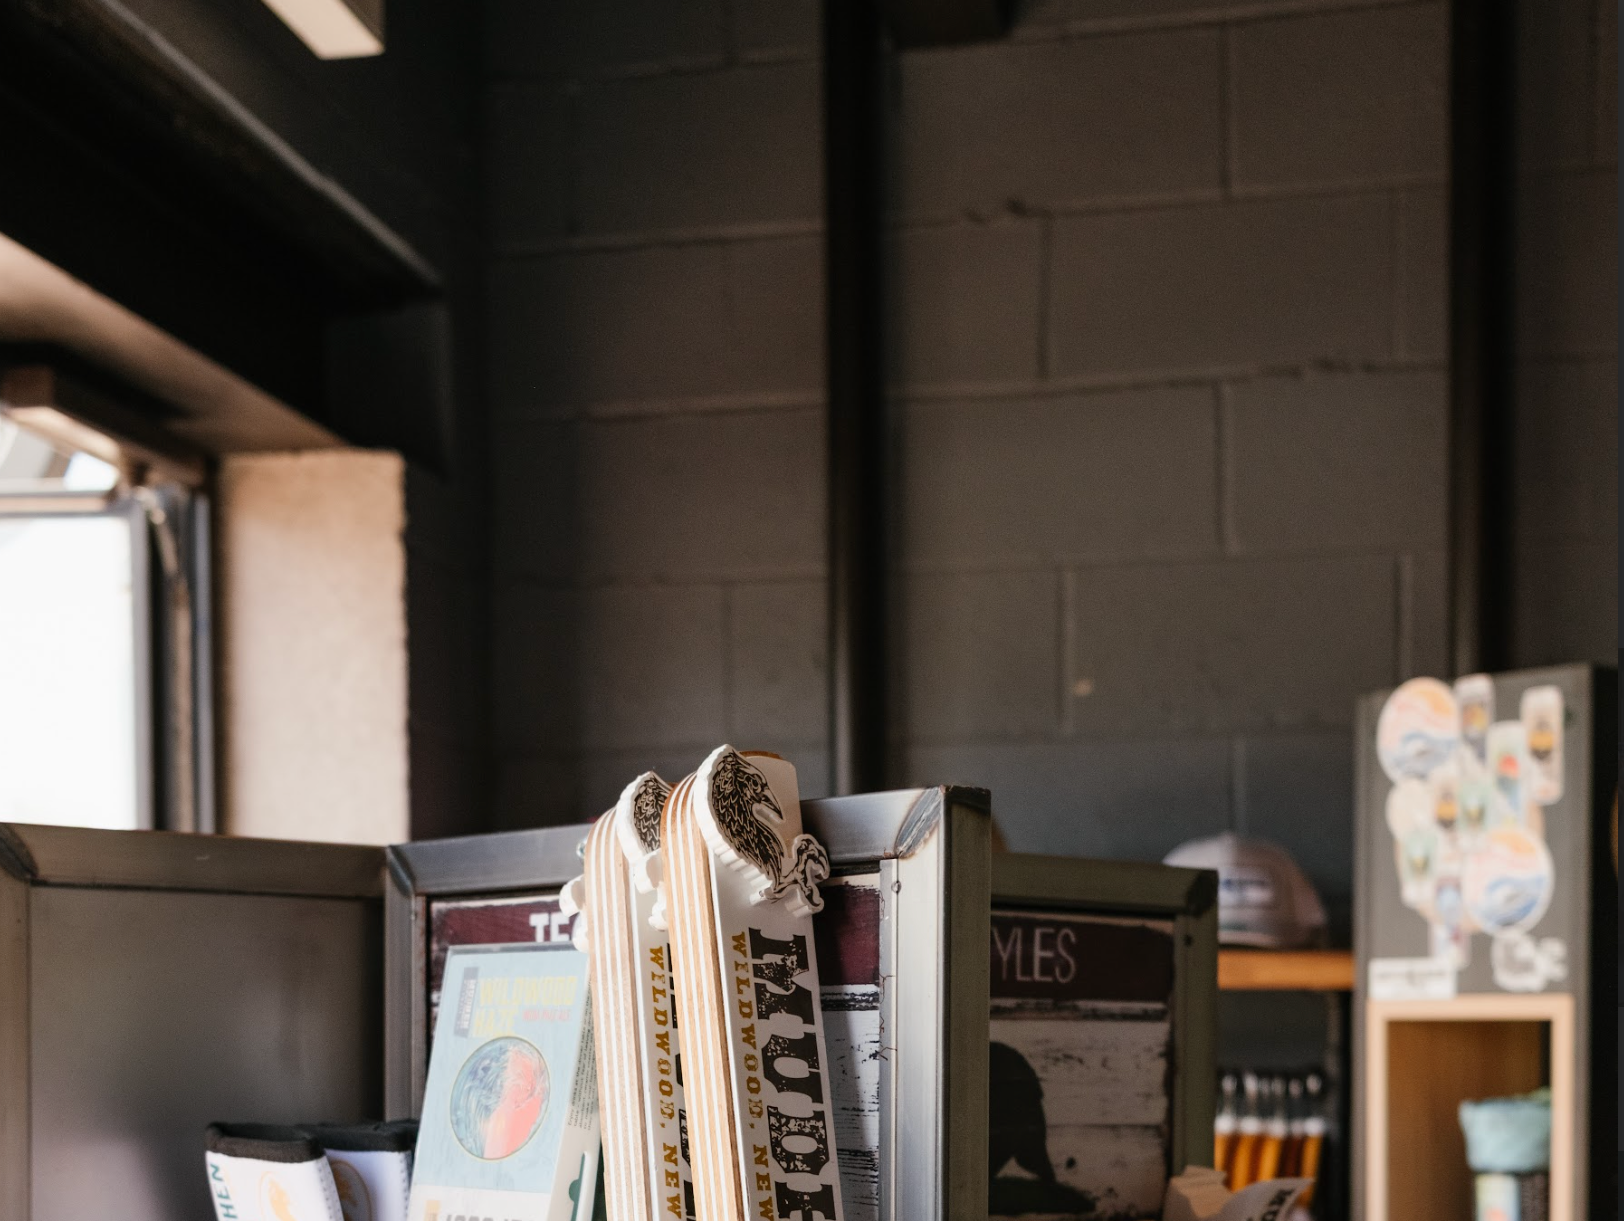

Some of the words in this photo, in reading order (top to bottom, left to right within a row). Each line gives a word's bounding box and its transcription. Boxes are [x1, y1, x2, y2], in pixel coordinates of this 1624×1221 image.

[479, 976, 578, 1006] WILDWOOD
[992, 927, 1077, 983] YLES
[649, 946, 675, 1128] WILDWOOD,
[662, 1142, 682, 1220] NEW
[731, 931, 764, 1129] WILDWOOD,
